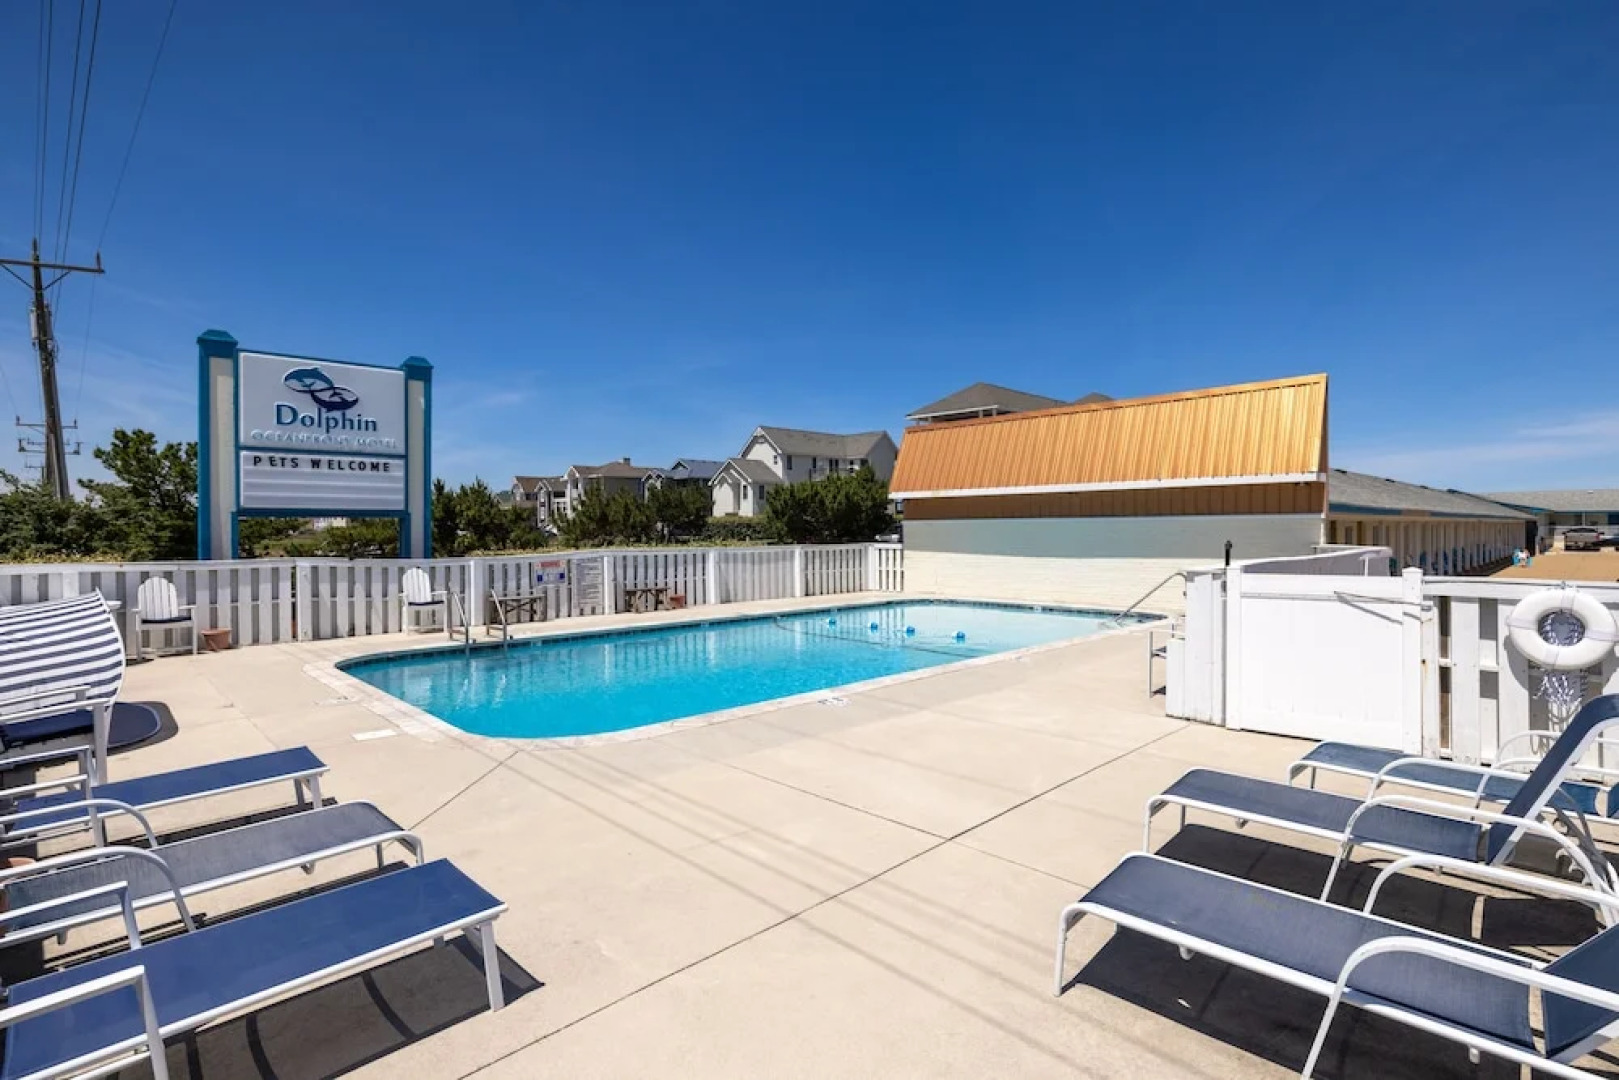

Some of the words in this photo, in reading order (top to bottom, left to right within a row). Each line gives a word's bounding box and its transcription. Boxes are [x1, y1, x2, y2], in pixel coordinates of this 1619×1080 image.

[275, 403, 377, 432] Dolphin
[253, 456, 299, 468] PETS
[310, 458, 390, 472] WELCOME
